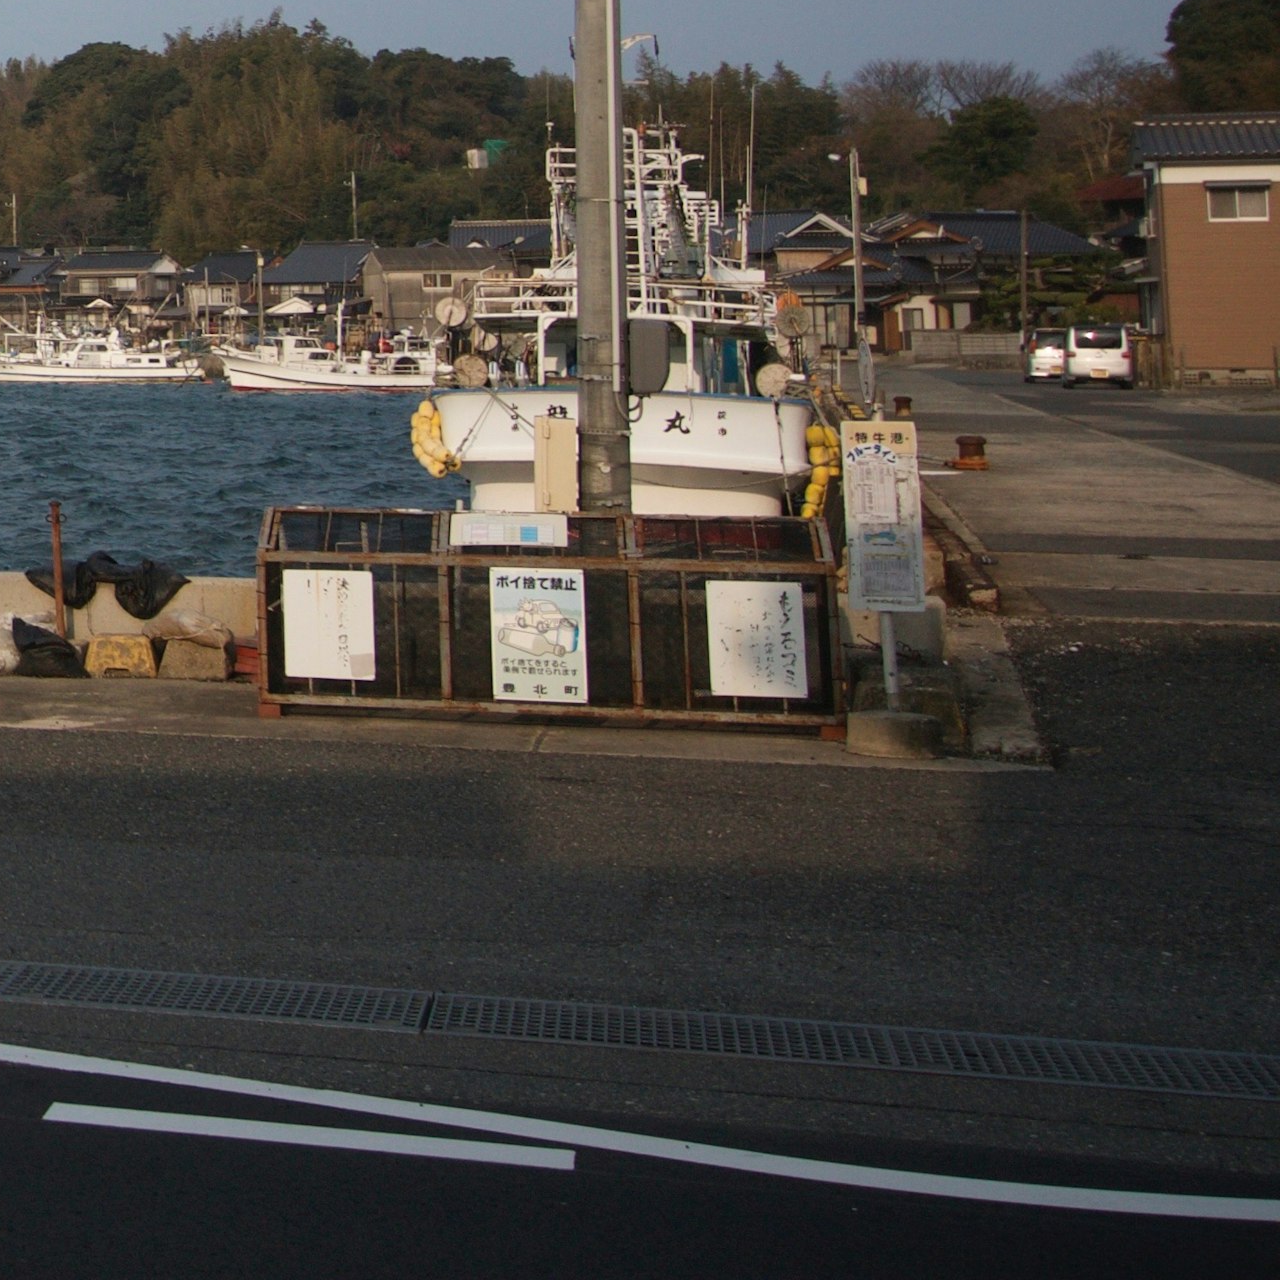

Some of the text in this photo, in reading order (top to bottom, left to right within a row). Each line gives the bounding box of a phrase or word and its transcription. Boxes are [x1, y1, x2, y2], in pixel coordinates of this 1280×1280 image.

[496, 575, 577, 591] ポイ捨て禁止
